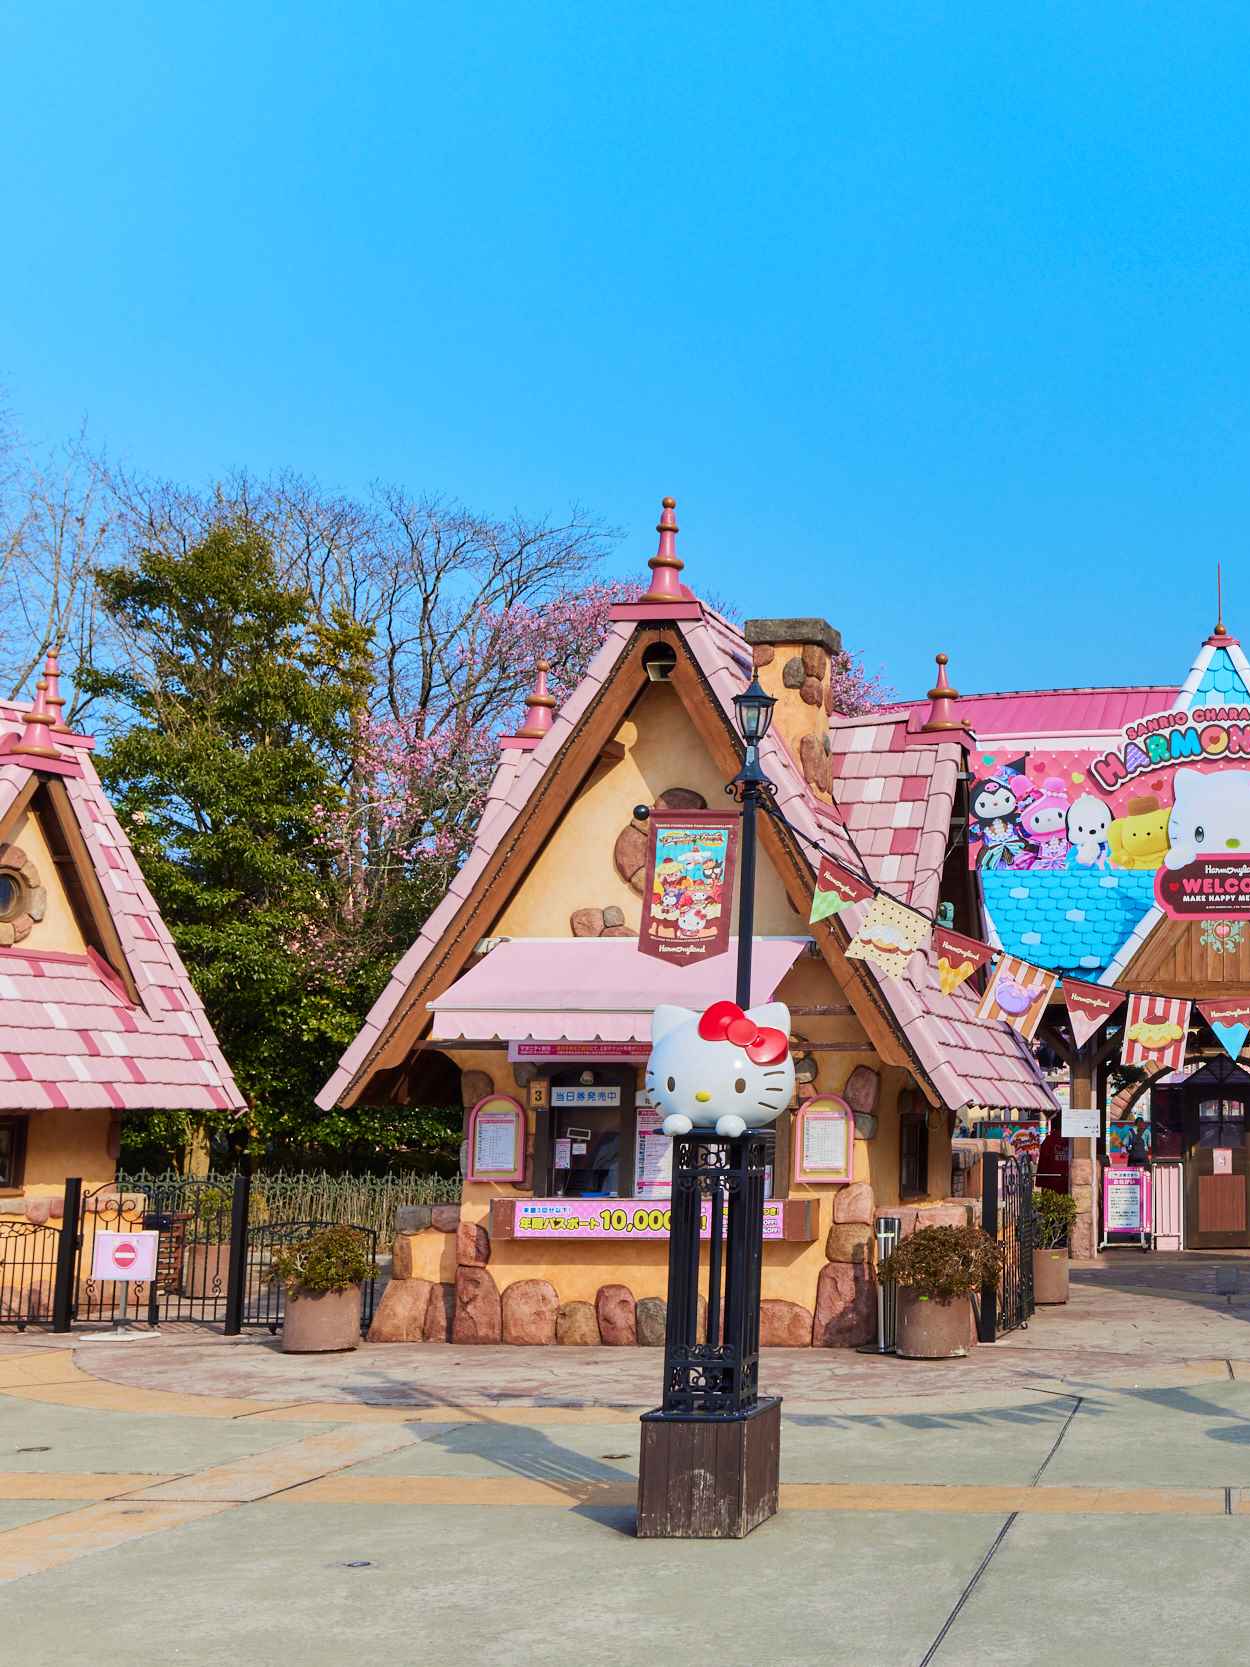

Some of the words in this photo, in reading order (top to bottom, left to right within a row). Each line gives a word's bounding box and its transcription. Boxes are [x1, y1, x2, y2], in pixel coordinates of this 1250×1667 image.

[1126, 711, 1188, 740] SANRIO
[1182, 894, 1207, 902] MAKE
[1208, 894, 1236, 902] HAPPY
[534, 1090, 542, 1101] 3
